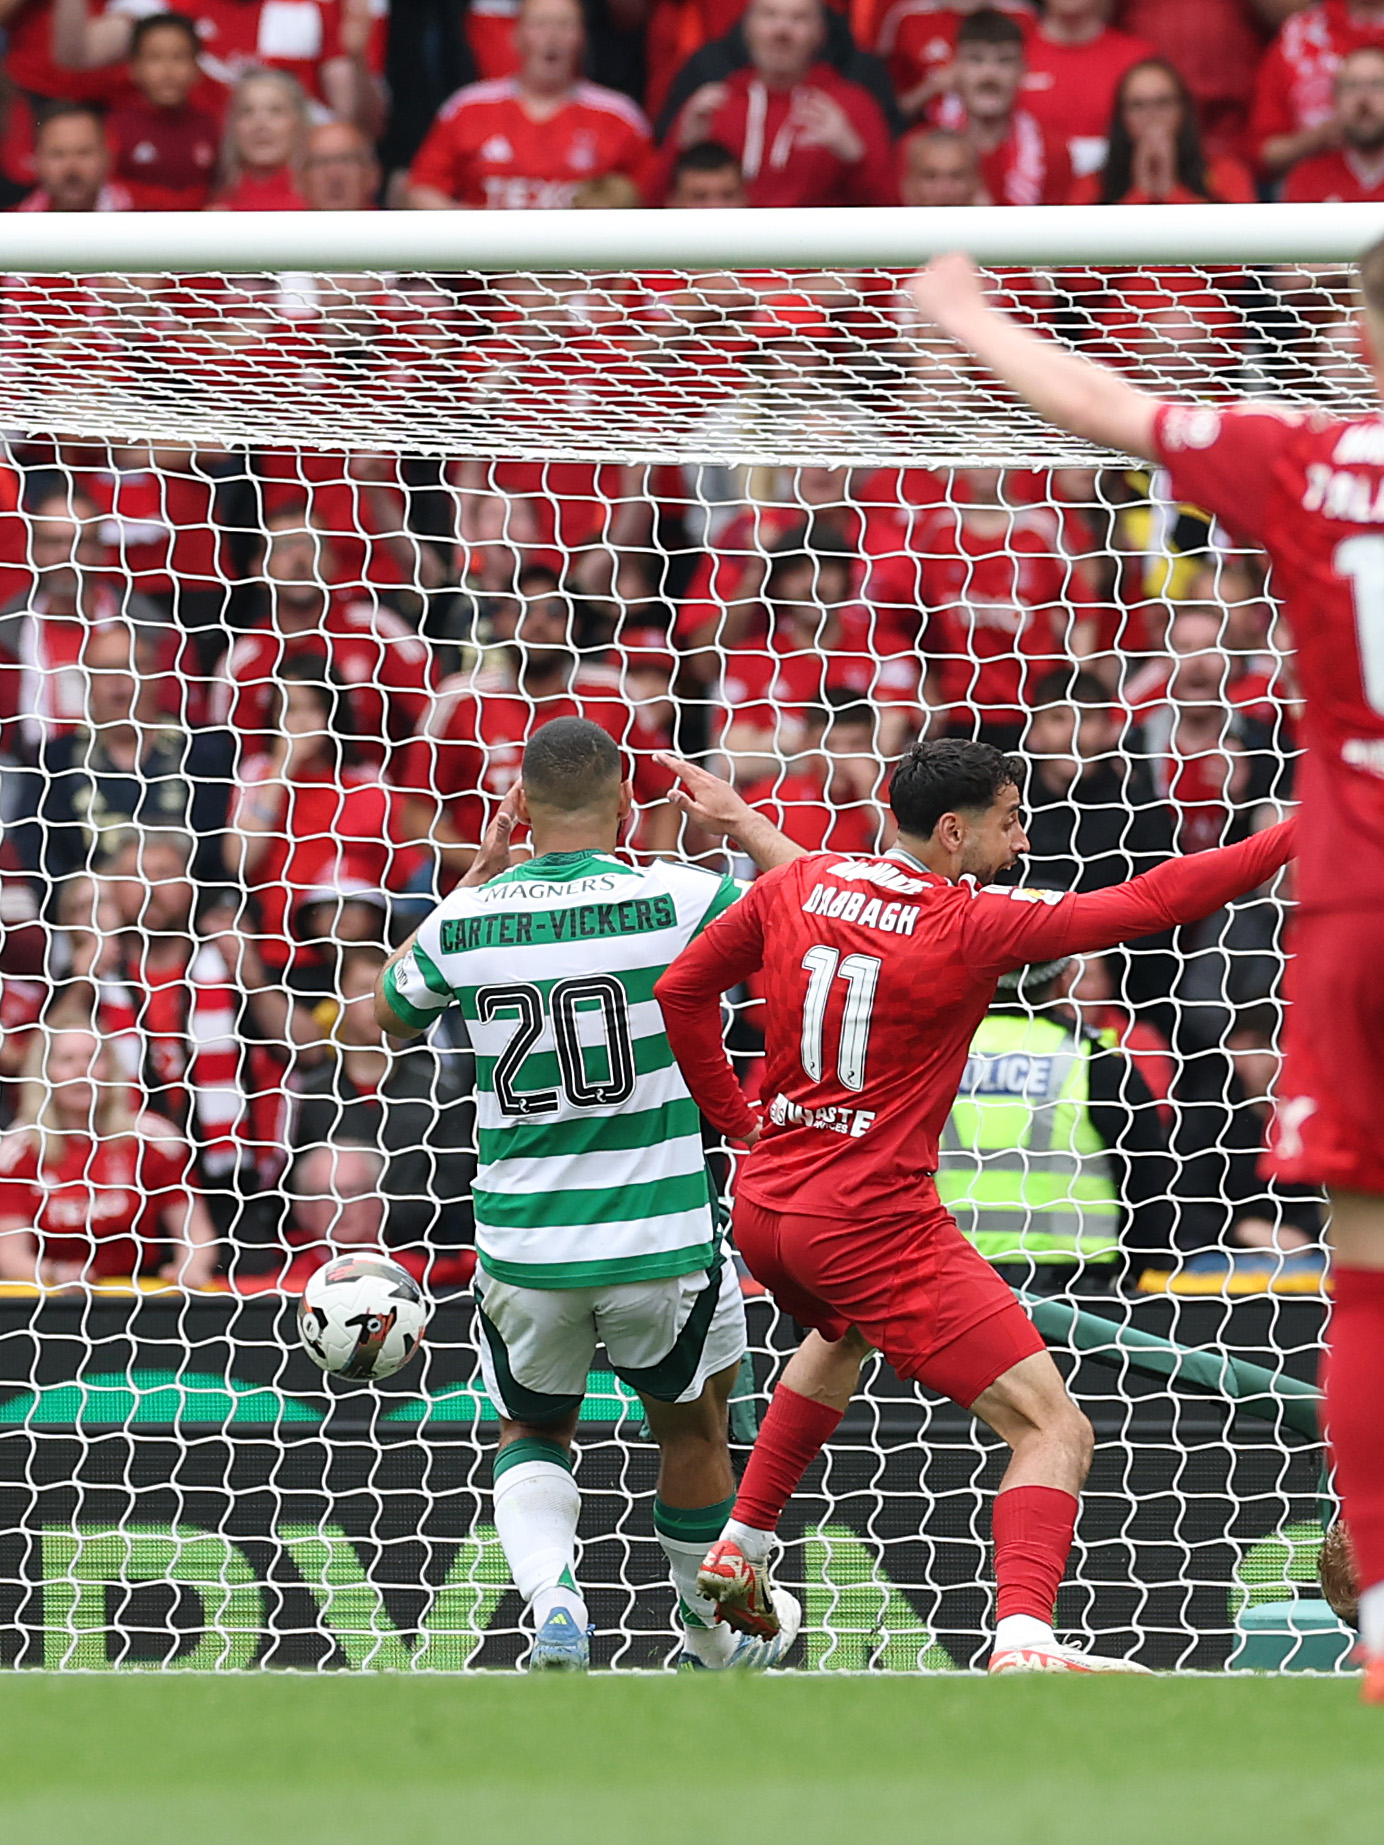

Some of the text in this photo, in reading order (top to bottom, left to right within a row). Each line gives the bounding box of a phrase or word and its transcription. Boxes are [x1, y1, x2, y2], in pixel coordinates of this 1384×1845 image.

[485, 873, 616, 903] MAGNERS
[802, 883, 921, 936] DABBAGH
[442, 896, 673, 948] CARTER-VICKERS
[801, 944, 882, 1093] 11
[475, 973, 637, 1119] 20
[960, 1056, 1048, 1094] OLICE
